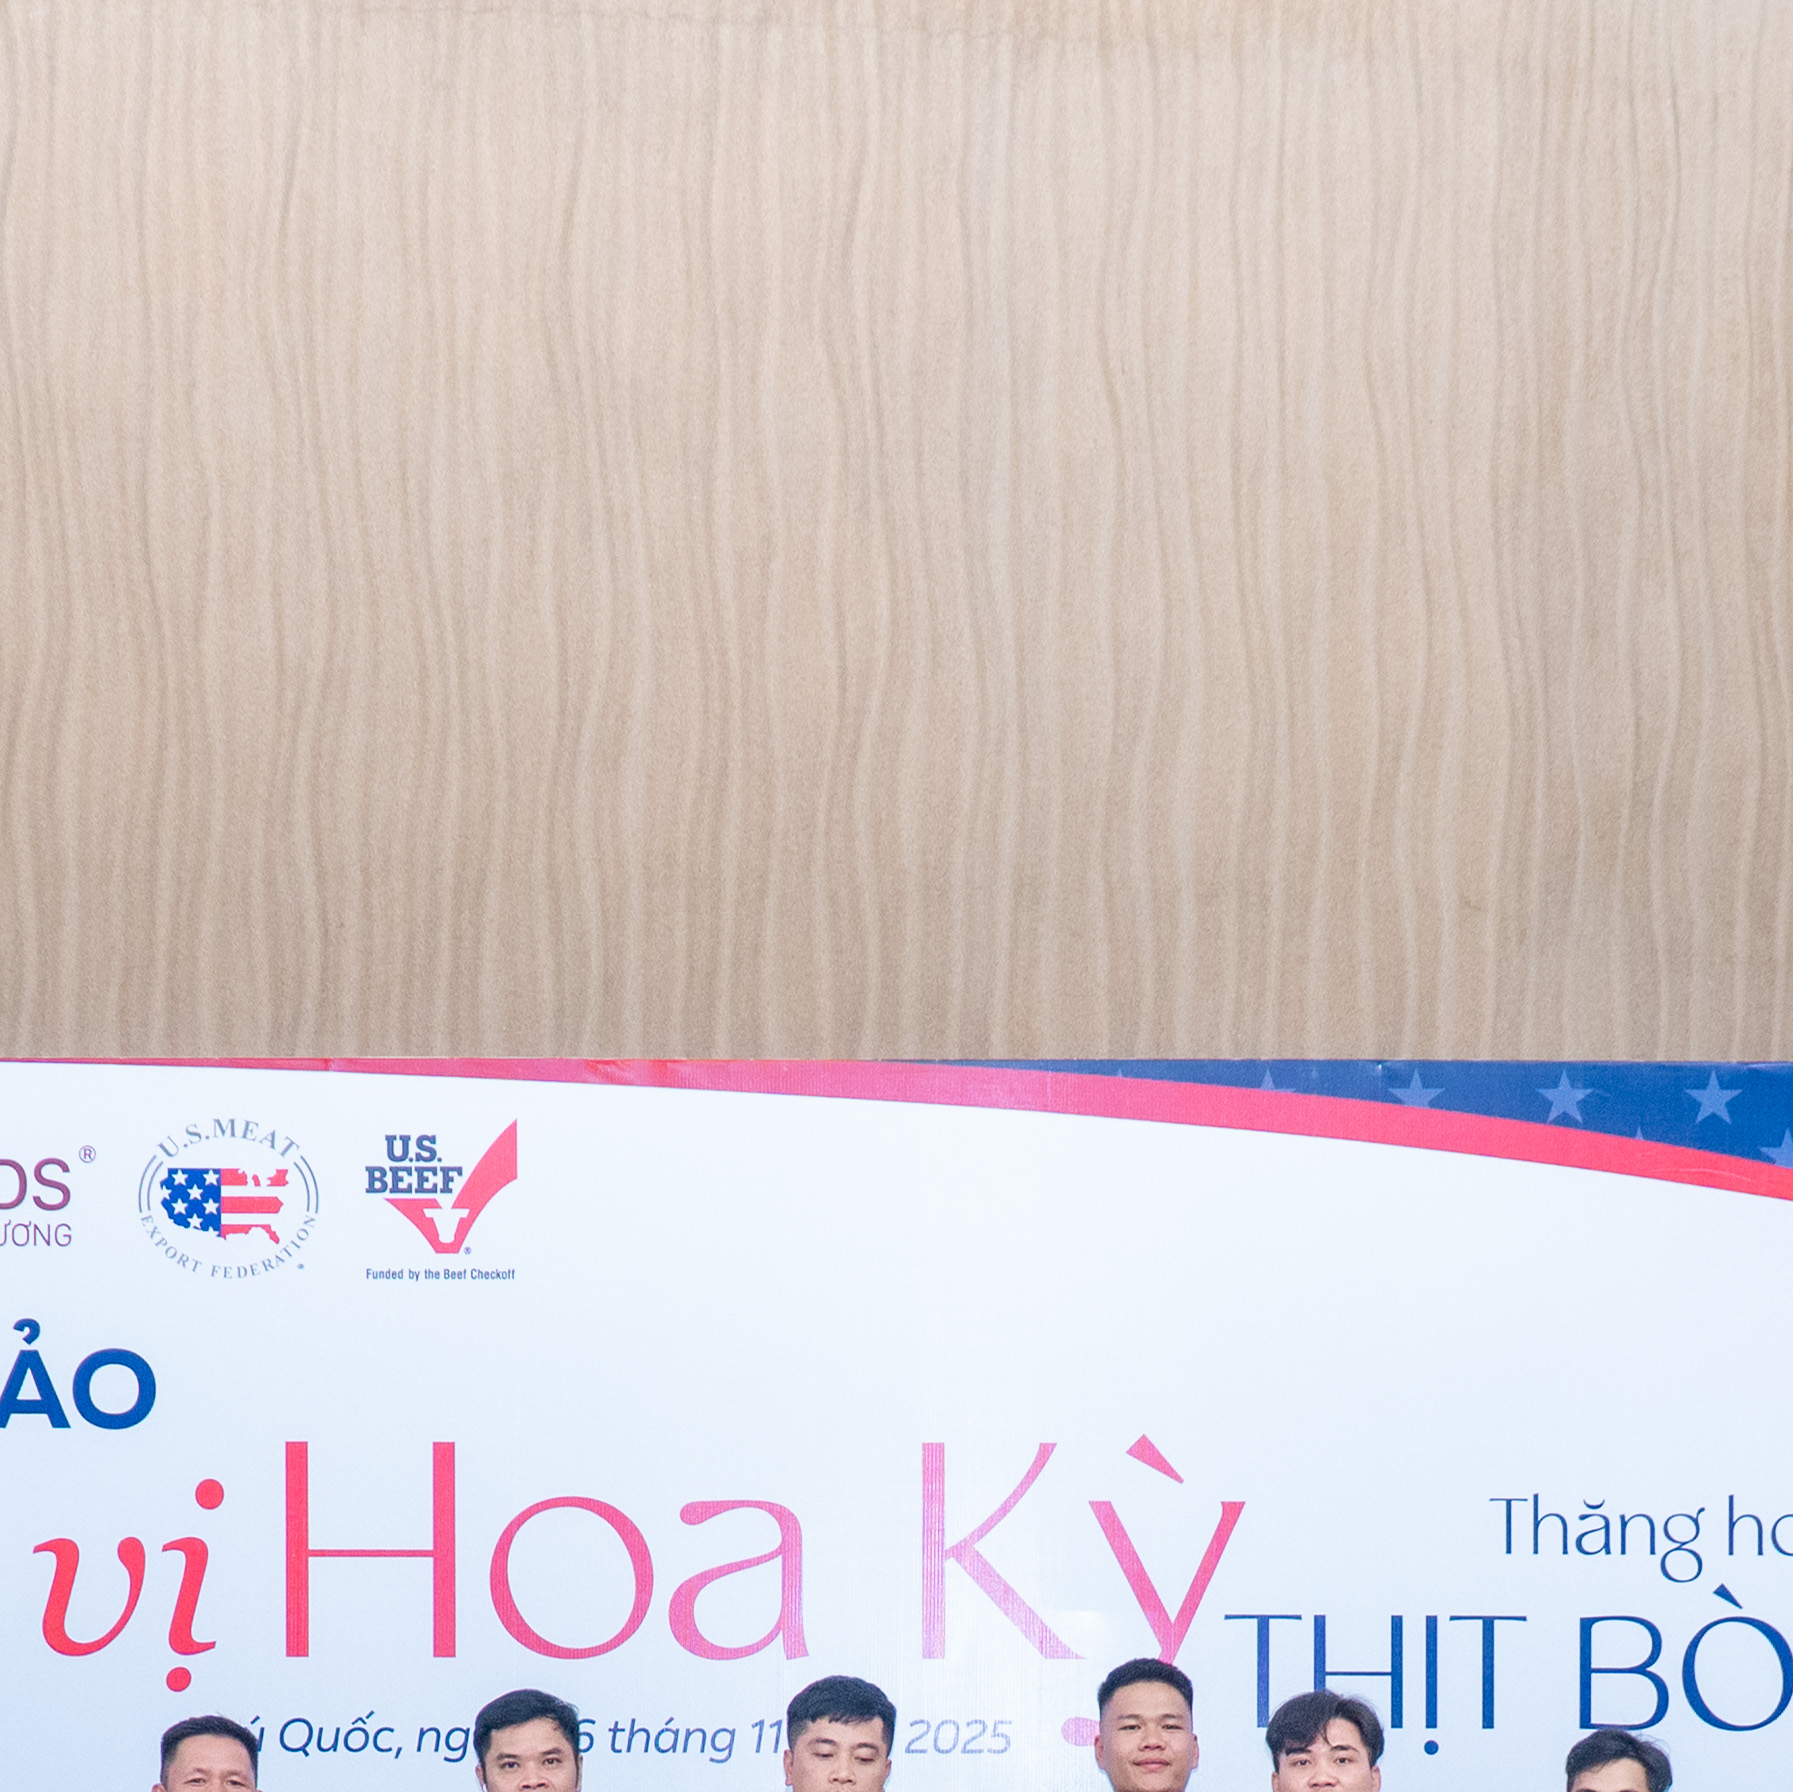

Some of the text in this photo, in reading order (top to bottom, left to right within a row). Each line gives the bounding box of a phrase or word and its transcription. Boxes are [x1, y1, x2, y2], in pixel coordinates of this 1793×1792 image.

[385, 1134, 443, 1162] U.S.
[365, 1166, 463, 1194] BEEF
[141, 1214, 316, 1279] EXPORT FEDERATION
[366, 1268, 516, 1282] Funded by the Beef Checkoff
[1489, 1494, 1706, 1584] Thăng
[32, 1478, 225, 1692] vị
[284, 1440, 809, 1661] Hoa
[921, 1434, 1247, 1748] Kỳ
[1224, 1613, 1528, 1756] THỊT
[279, 1710, 403, 1760] Quốc,
[416, 1726, 472, 1764] ng
[608, 1716, 736, 1764] tháng
[904, 1718, 1014, 1755] 2025
